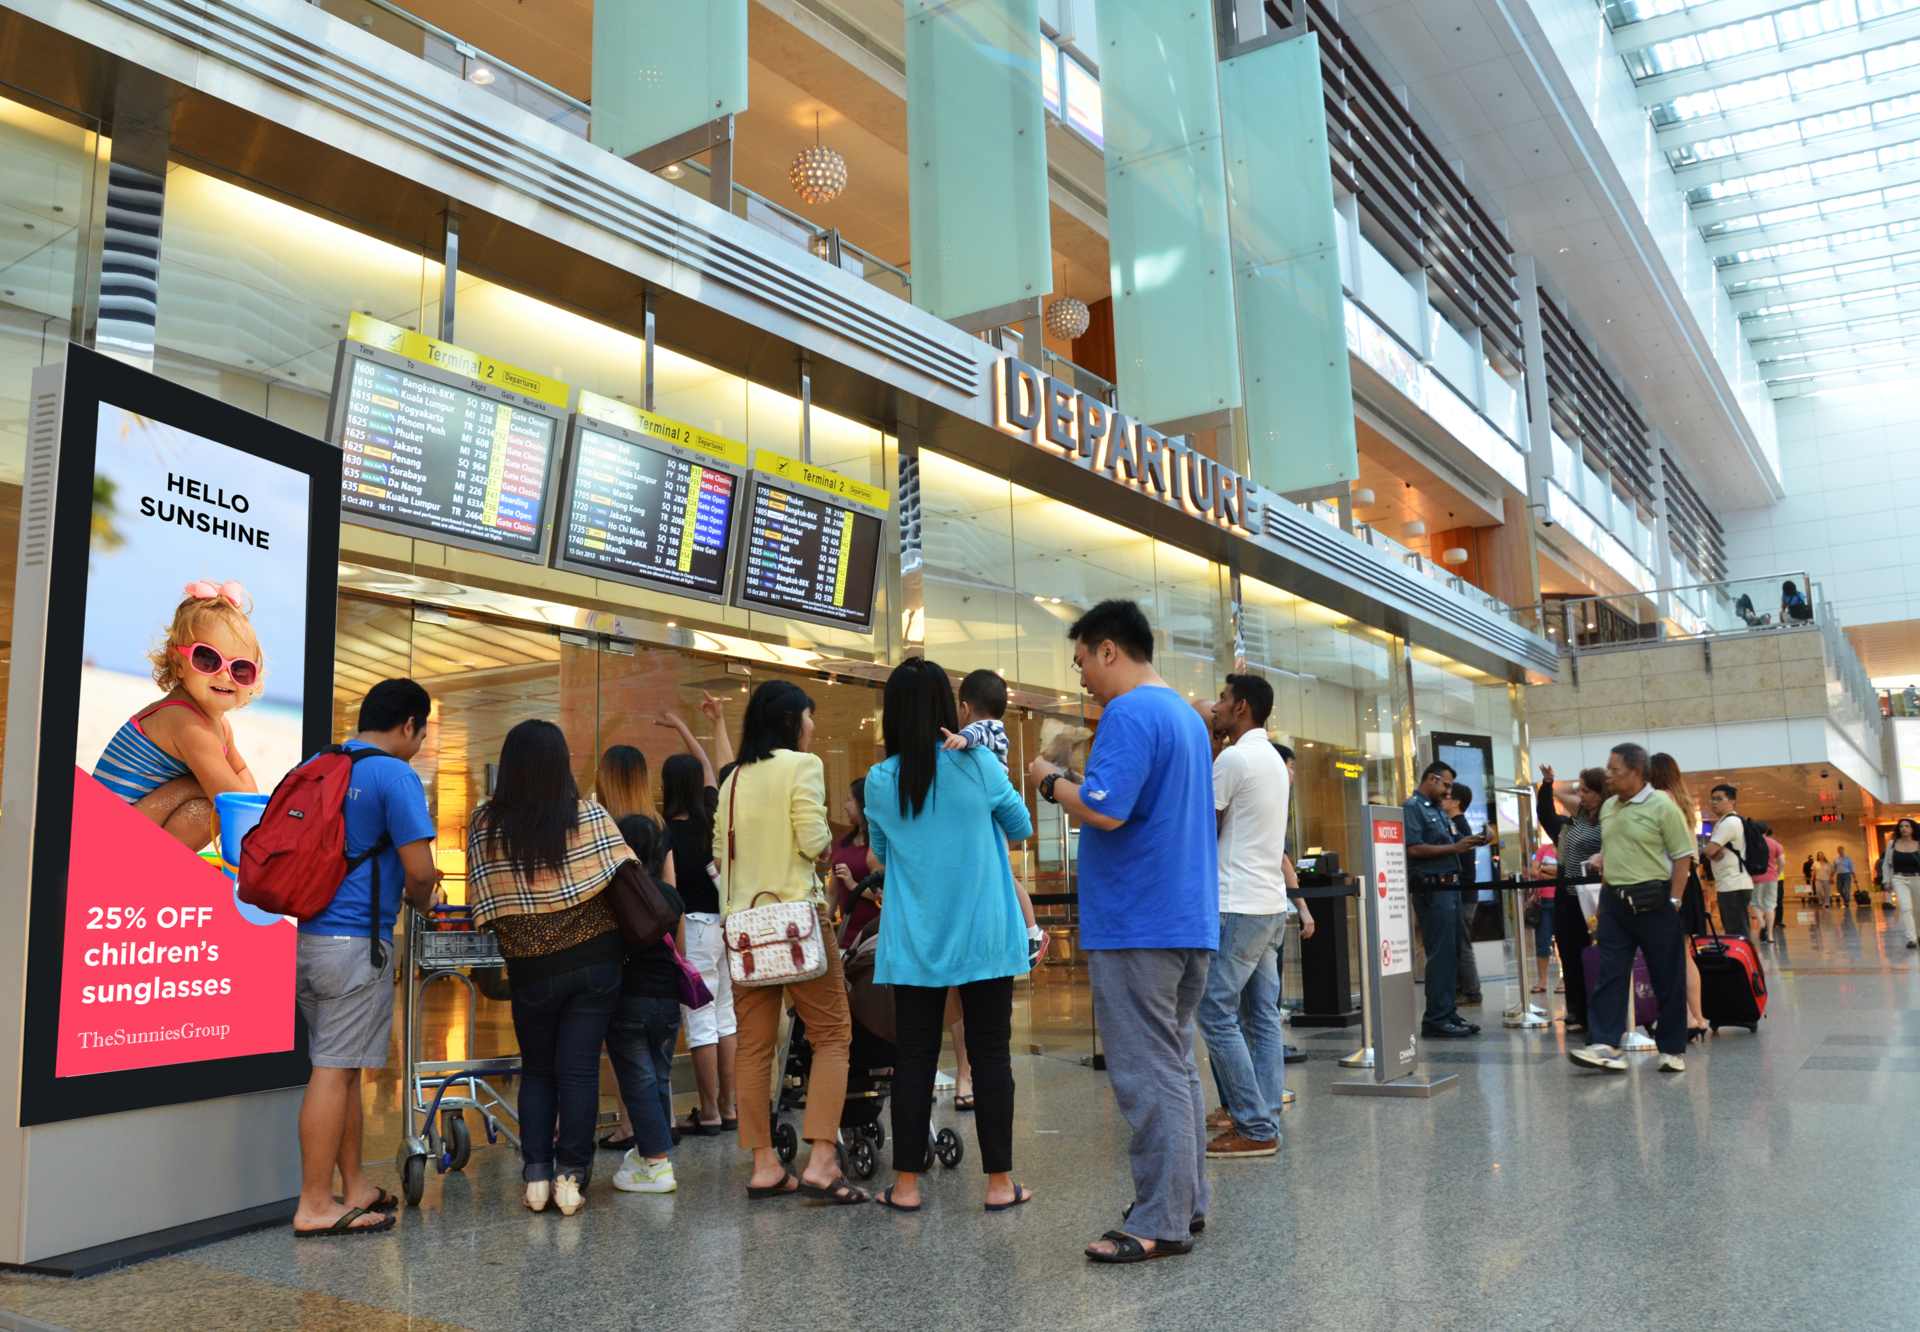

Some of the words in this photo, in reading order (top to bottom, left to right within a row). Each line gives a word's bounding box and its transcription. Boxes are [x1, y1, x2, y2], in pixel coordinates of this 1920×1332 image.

[360, 345, 374, 356] Time
[407, 361, 414, 369] To
[471, 381, 486, 392] Flight
[502, 391, 515, 400] Gate
[523, 398, 546, 411] Remarks
[428, 344, 482, 375] Terminal
[486, 365, 494, 379] 2
[504, 372, 538, 390] Departures
[354, 376, 373, 389] 1615
[400, 390, 423, 404] Kuala
[425, 398, 455, 413] Lumpur
[465, 410, 475, 419] MI
[479, 414, 493, 424] 338
[510, 424, 540, 438] Cancelled
[355, 363, 375, 376] 1600
[403, 378, 455, 401] Bangkok-BKK
[467, 398, 478, 409] SQ
[481, 402, 494, 412] 976
[499, 408, 510, 416] E12
[512, 412, 526, 423] Gate
[528, 416, 549, 429] Closed
[350, 402, 369, 414] 1620
[397, 415, 425, 430] Phnom
[426, 423, 446, 436] Penh
[462, 434, 472, 443] MI
[476, 438, 489, 448] 608
[507, 447, 522, 458] Gate
[523, 452, 546, 465] Closing
[352, 389, 371, 401] 1615
[399, 402, 444, 423] Yogyakarta
[464, 422, 473, 431] TR
[477, 426, 495, 438] 2214
[509, 436, 524, 446] Gate
[525, 440, 547, 455] Closing
[639, 415, 680, 440] Terminal
[684, 431, 690, 443] 2
[698, 438, 723, 451] Departures
[346, 428, 365, 440] 1625
[393, 440, 422, 455] Jakarta
[458, 458, 469, 469] SQ
[472, 462, 486, 472] 964
[504, 471, 519, 481] Gate
[520, 475, 542, 489] Closing
[348, 415, 367, 427] 1625
[395, 428, 423, 443] Phuket
[460, 446, 470, 455] MI
[474, 450, 487, 460] 756
[505, 459, 520, 469] Gate
[522, 464, 544, 477] Closing
[1003, 356, 1261, 536] DEPARTURE
[344, 440, 364, 452] 1625
[392, 453, 421, 470] Penang
[457, 470, 466, 479] TR
[470, 474, 488, 485] 2422
[502, 483, 517, 493] Gate
[518, 487, 541, 501] Closing
[390, 466, 426, 482] Surabaya
[455, 482, 465, 492] MI
[468, 486, 482, 496] 226
[500, 494, 528, 509] Boarding
[614, 478, 638, 490] Yangon
[615, 467, 633, 477] Kuala
[634, 472, 657, 484] Lumpur
[804, 469, 836, 489] Terminal
[839, 482, 844, 492] 2
[167, 472, 250, 514] HELLO
[343, 467, 360, 479] 635
[388, 478, 399, 488] Da
[401, 481, 422, 495] Nang
[453, 494, 463, 504] MI
[467, 498, 485, 509] 633A
[499, 506, 514, 516] Gate
[515, 510, 532, 521] Open
[359, 498, 373, 508] 2013
[378, 504, 394, 512] 16:11
[386, 491, 408, 503] Kuala
[411, 497, 441, 511] Lumpur
[452, 506, 461, 516] TR
[465, 510, 482, 521] 2464
[497, 518, 512, 528] Gate
[514, 522, 536, 535] Closing
[575, 490, 590, 500] 1705
[611, 500, 627, 511] Hong
[629, 504, 645, 516] Kong
[661, 513, 668, 521] TR
[696, 523, 707, 531] Gate
[708, 527, 721, 535] Open
[576, 479, 591, 489] 1705
[613, 489, 633, 501] Manila
[662, 502, 670, 512] SQ
[140, 496, 270, 550] SUNSHINE
[570, 524, 585, 534] 1735
[606, 533, 648, 549] Bangkok-BKK
[657, 545, 664, 553] TZ
[667, 548, 678, 556] 302
[572, 513, 586, 522] 1735
[608, 522, 617, 530] Ho
[619, 525, 628, 533] Chi
[630, 527, 645, 537] Minh
[658, 534, 666, 544] SQ
[693, 543, 704, 552] New
[705, 547, 717, 555] Gate
[573, 501, 588, 511] 1720
[609, 511, 632, 522] Jakarta
[659, 523, 668, 533] SQ
[694, 533, 706, 542] Gate
[707, 537, 720, 545] Open
[569, 535, 583, 545] 1740
[605, 544, 626, 555] Manila
[1378, 826, 1398, 839] NOTICE
[86, 906, 147, 930] 25%
[156, 906, 214, 928] OFF
[82, 974, 232, 1006] sunglasses
[78, 1022, 230, 1049] TheSunniesGroup
